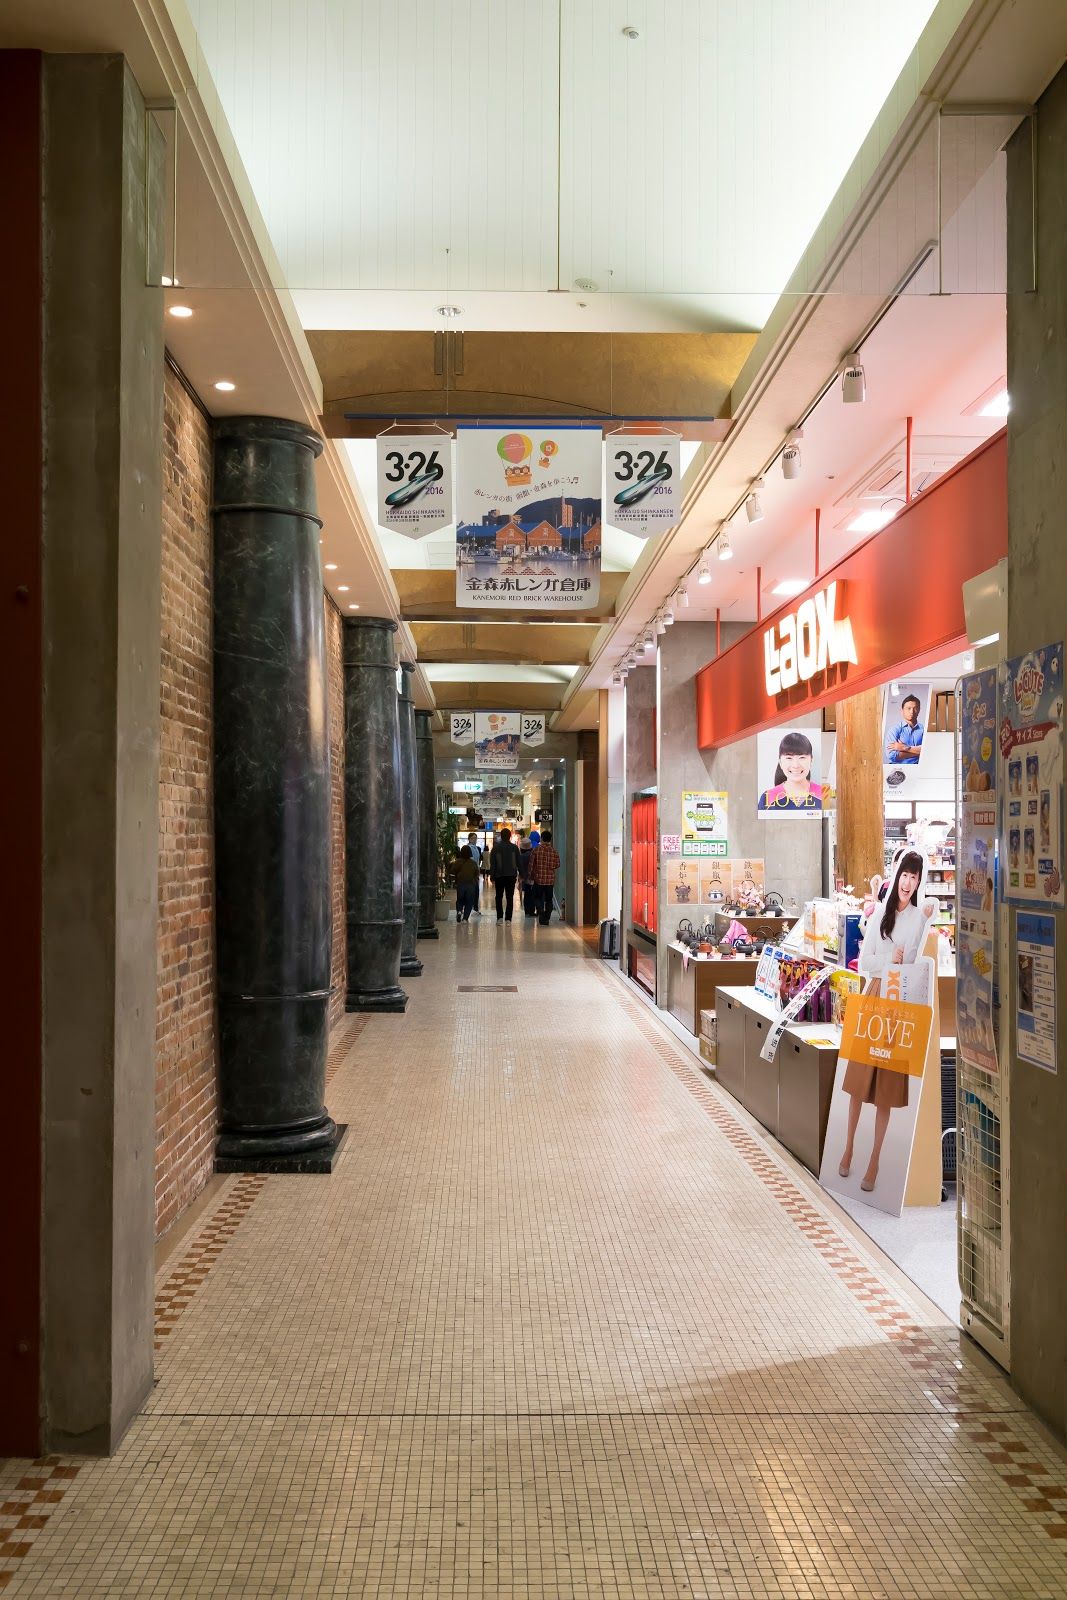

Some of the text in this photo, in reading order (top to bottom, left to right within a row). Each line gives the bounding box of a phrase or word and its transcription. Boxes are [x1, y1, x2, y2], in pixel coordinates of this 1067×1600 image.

[425, 486, 444, 495] 2016
[653, 486, 673, 495] 2016
[465, 577, 591, 591] 金森赤レンガ倉庫
[763, 790, 816, 808] LOVE
[854, 1012, 915, 1048] LOVE
